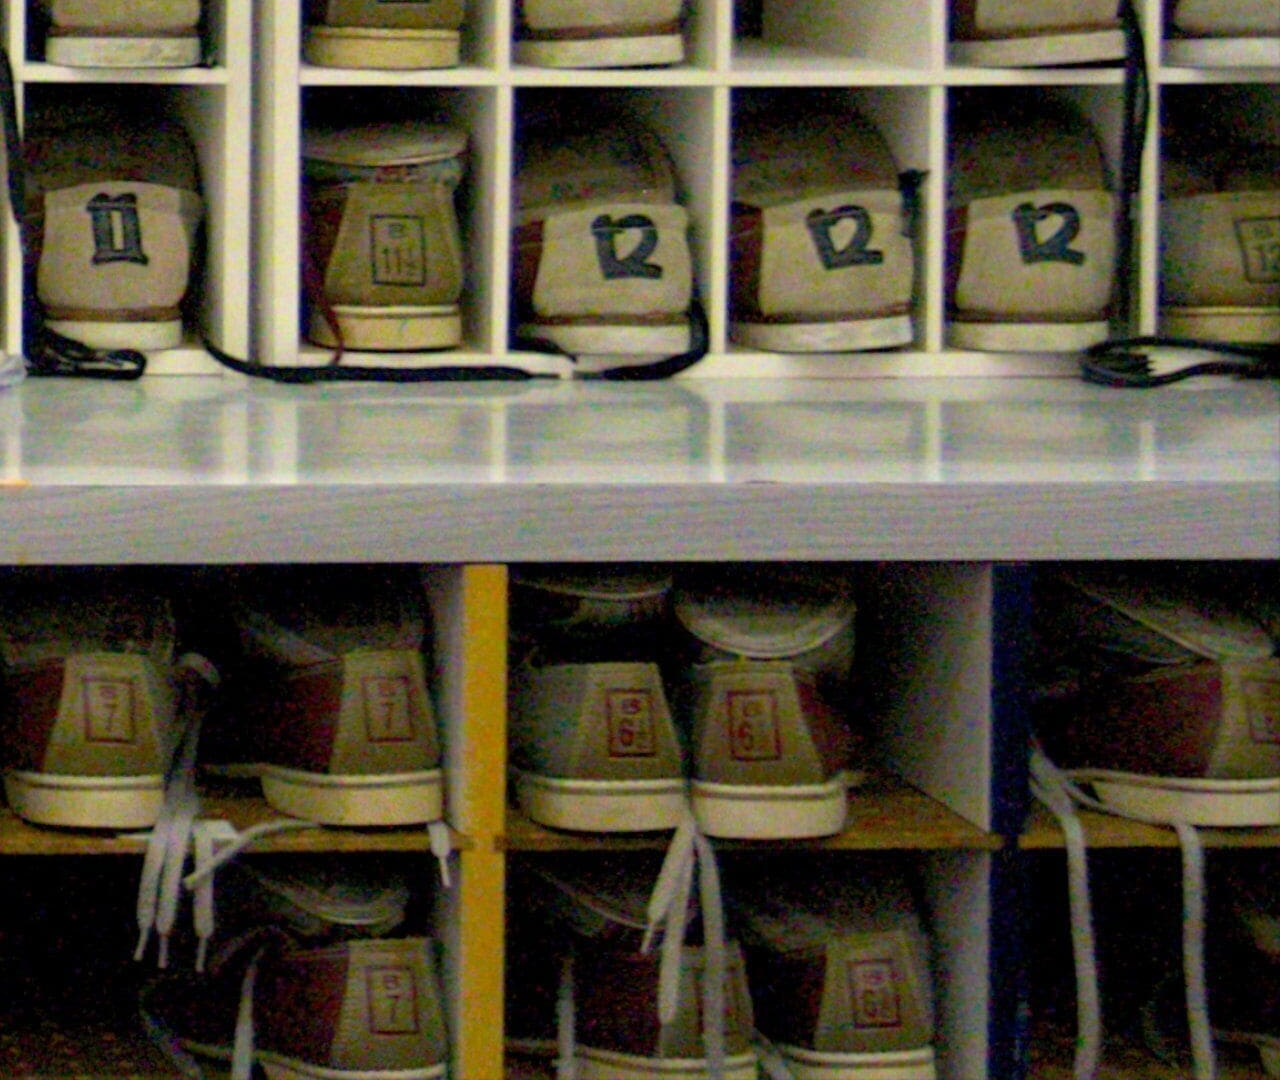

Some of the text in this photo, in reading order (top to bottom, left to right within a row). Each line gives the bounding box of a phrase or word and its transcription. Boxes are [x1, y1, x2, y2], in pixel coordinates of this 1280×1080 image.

[86, 192, 149, 266] 11
[591, 214, 663, 279] 12
[806, 204, 884, 270] 12
[1013, 202, 1085, 266] 12
